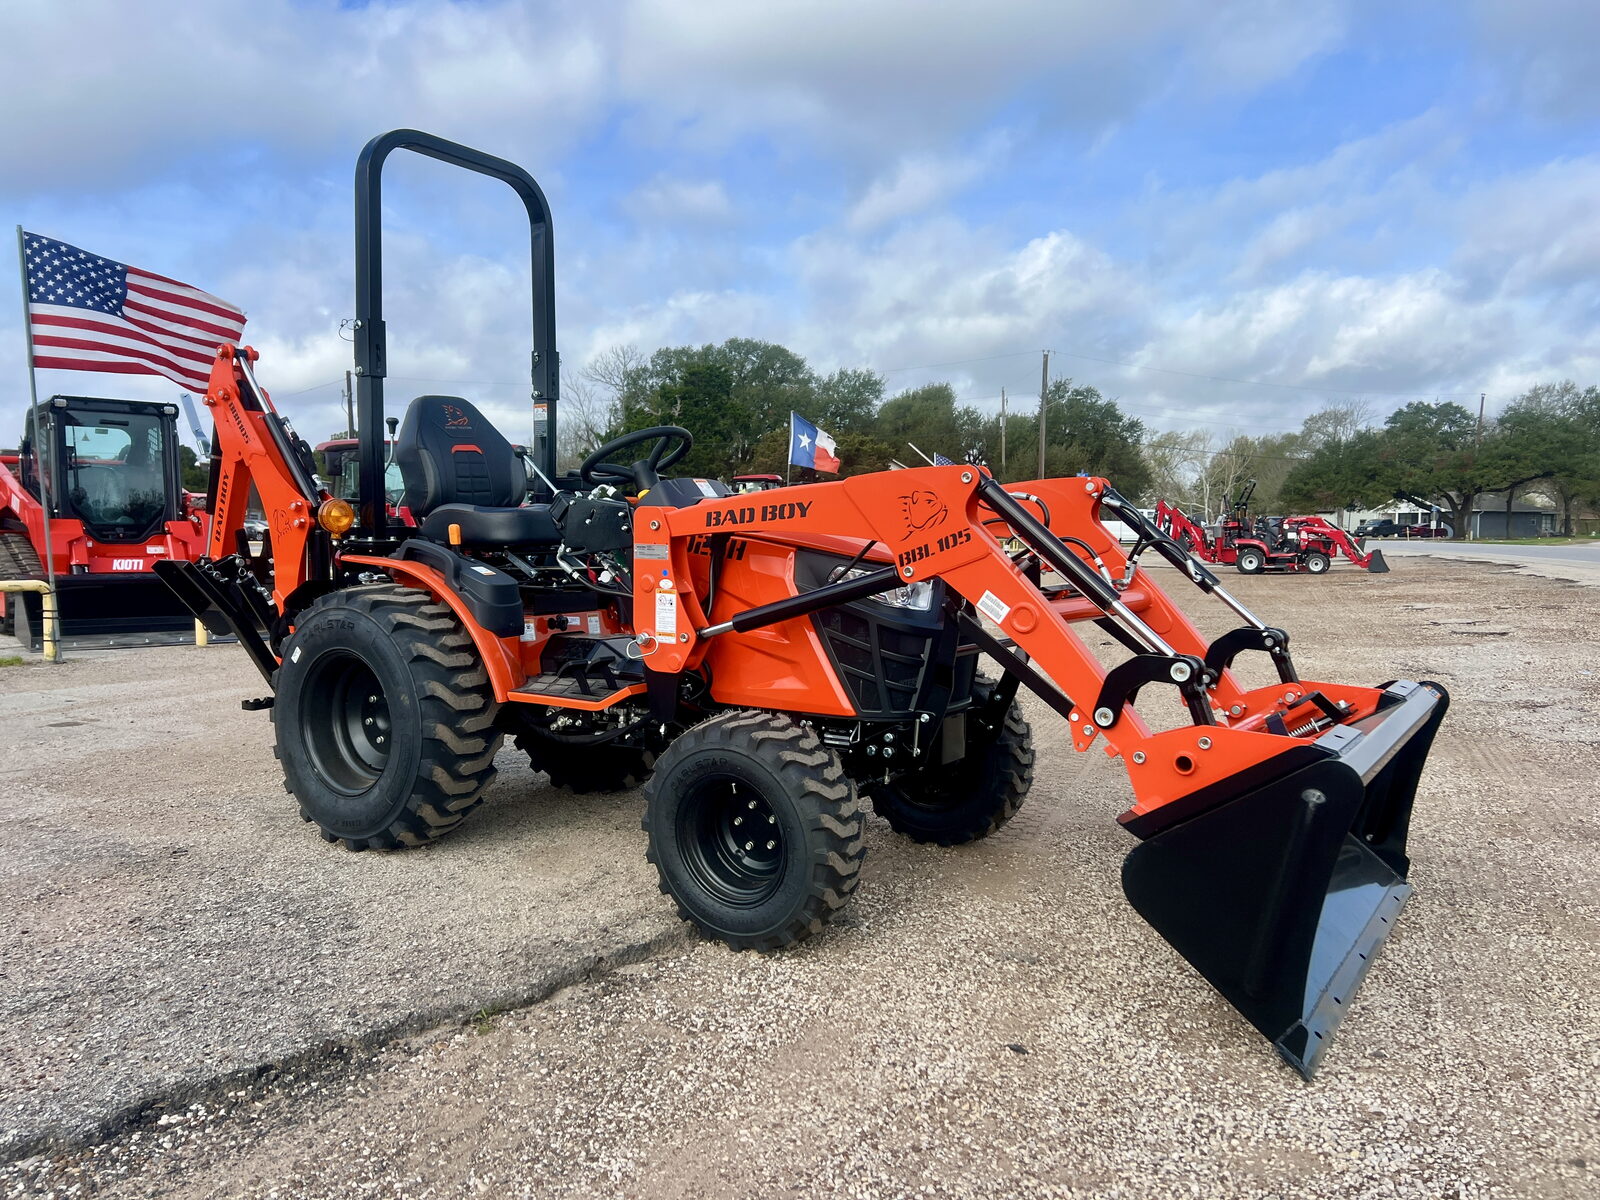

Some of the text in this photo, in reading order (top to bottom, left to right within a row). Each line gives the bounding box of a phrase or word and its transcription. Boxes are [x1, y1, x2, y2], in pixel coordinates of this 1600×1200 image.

[215, 469, 229, 542] BAD BOY
[705, 501, 813, 527] BAD BOY
[898, 528, 971, 568] BBL 105
[112, 559, 144, 571] KIOTI
